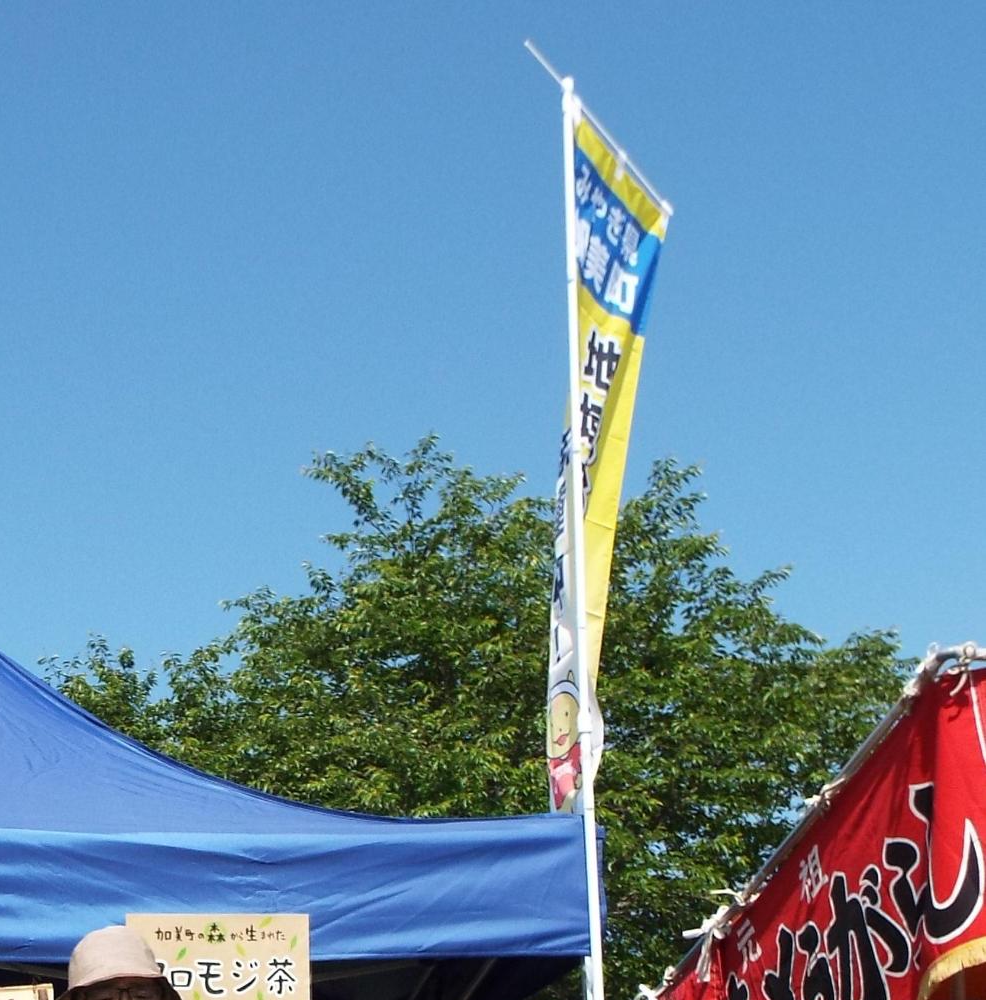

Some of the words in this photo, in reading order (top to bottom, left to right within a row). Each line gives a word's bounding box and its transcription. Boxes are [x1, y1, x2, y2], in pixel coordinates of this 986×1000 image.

[154, 922, 287, 943] 加美町の森から生まれた
